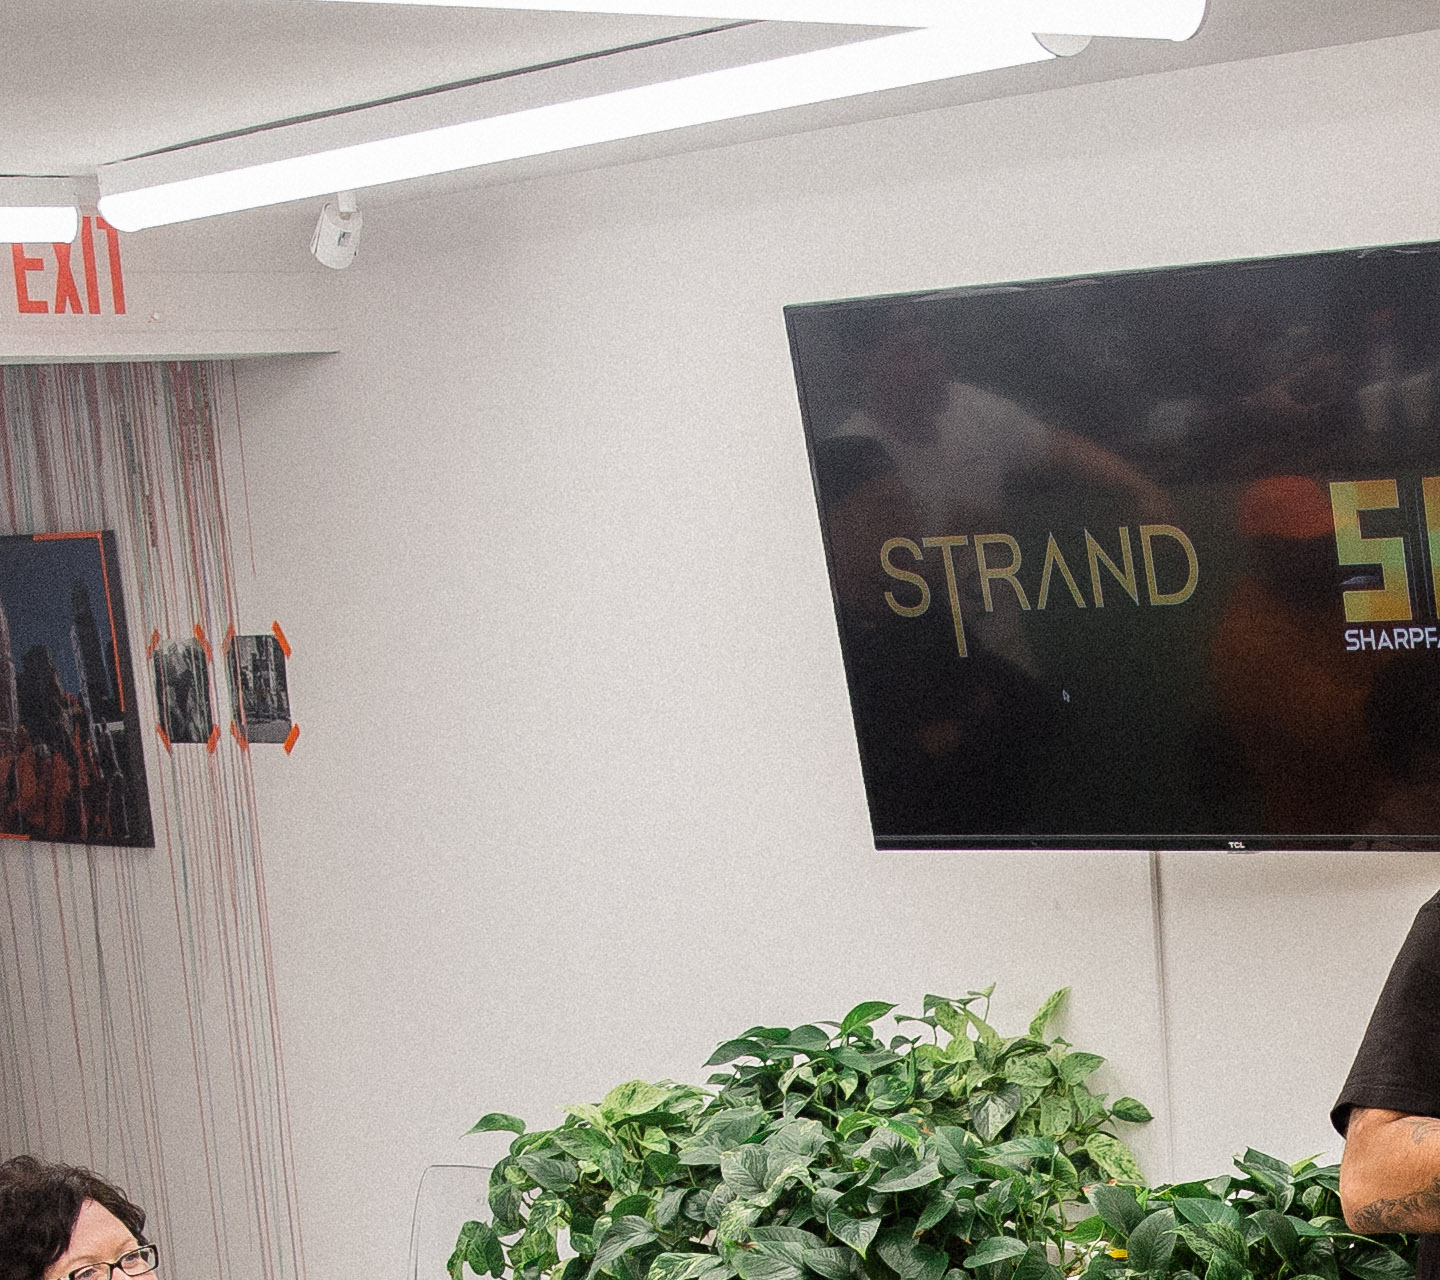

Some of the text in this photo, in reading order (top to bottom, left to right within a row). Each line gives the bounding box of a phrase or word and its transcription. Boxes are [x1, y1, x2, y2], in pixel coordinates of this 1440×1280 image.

[10, 216, 126, 315] EXIT
[879, 524, 1201, 659] STRAND
[1228, 841, 1246, 849] TCL
